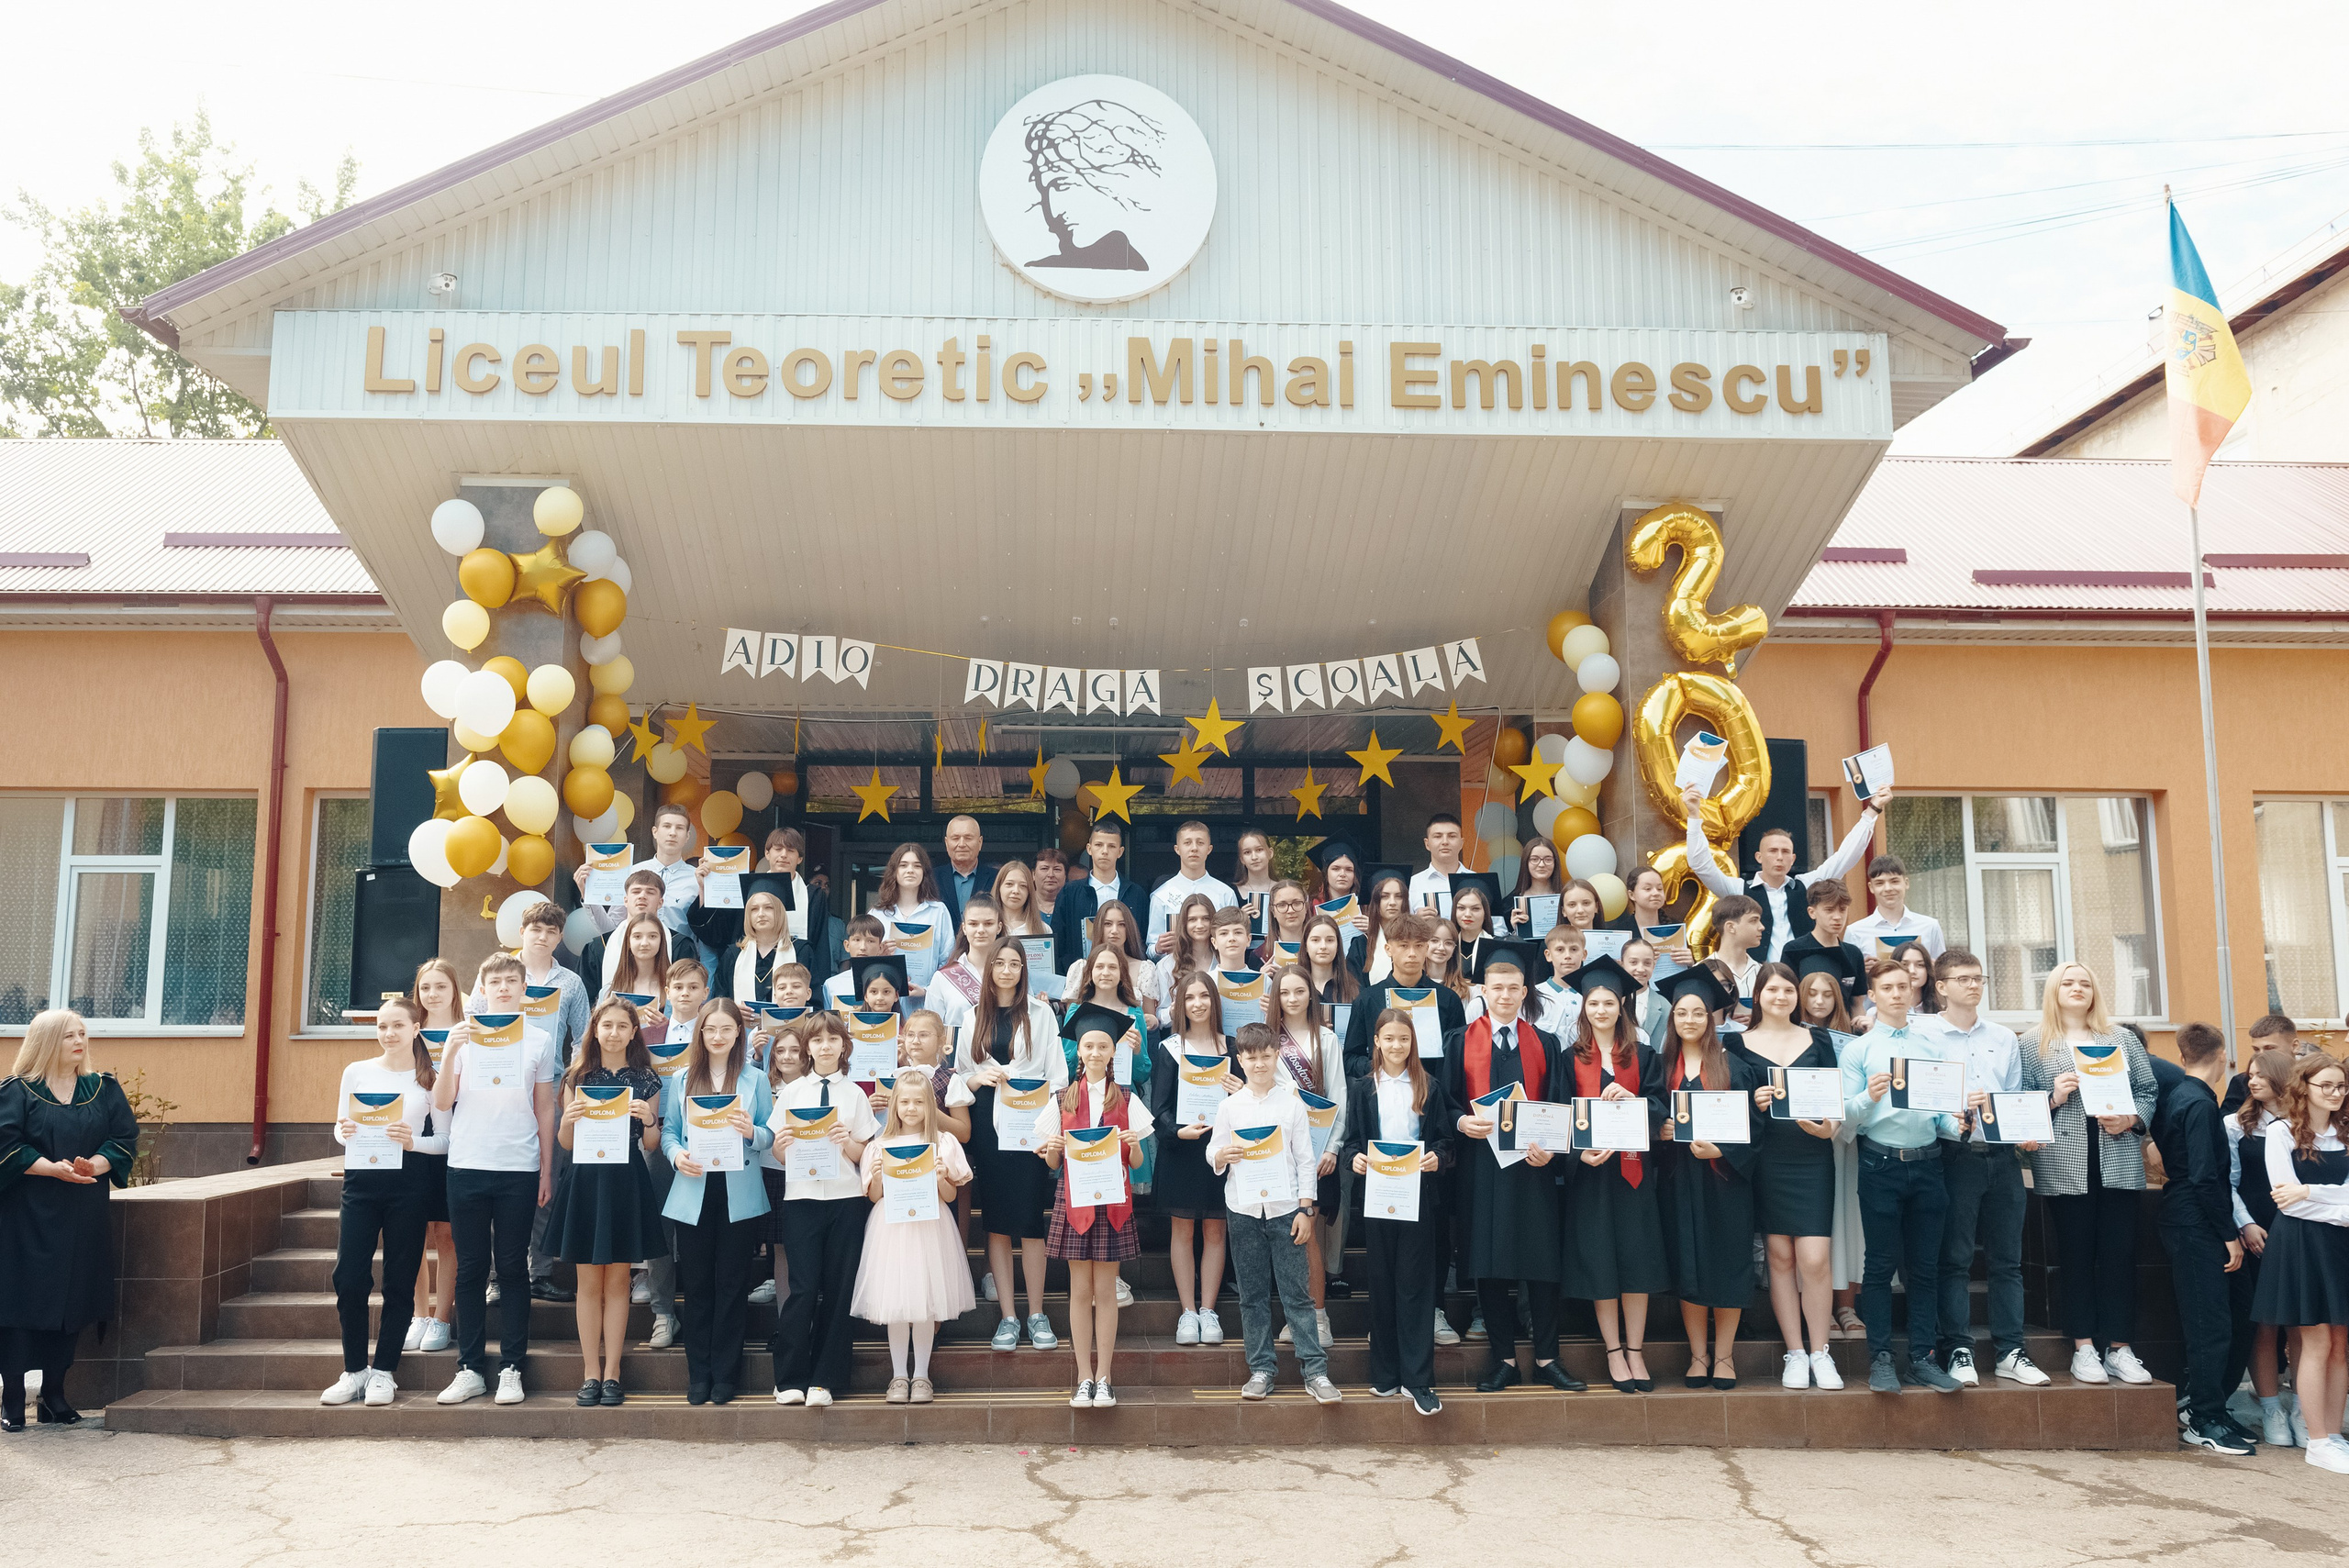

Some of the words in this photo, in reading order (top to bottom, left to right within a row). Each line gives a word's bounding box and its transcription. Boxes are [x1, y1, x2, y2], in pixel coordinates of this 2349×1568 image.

[363, 326, 645, 396] Liceul
[675, 330, 1049, 403] Teoretic
[727, 636, 869, 673] ADIO
